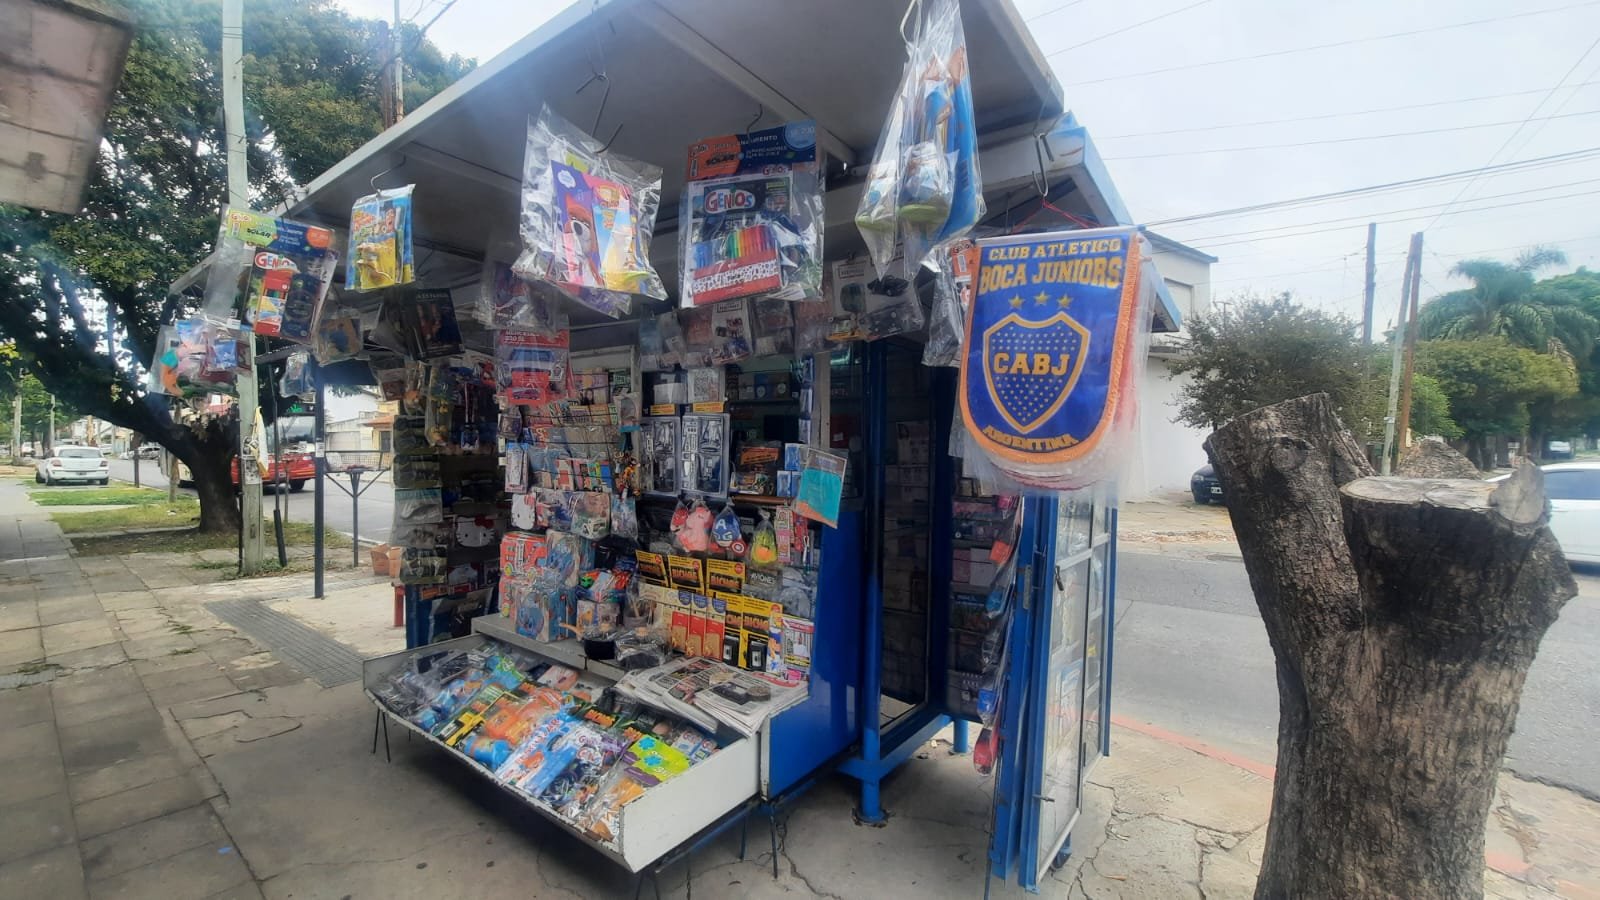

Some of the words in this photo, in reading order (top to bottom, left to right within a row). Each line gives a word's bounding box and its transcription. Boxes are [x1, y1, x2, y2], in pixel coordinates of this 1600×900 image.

[989, 246, 1031, 261] CLUB
[1033, 238, 1121, 258] ATLETICO
[979, 263, 1027, 295] BOCA
[1033, 257, 1122, 289] JUNIORS
[993, 352, 1071, 376] CABJ
